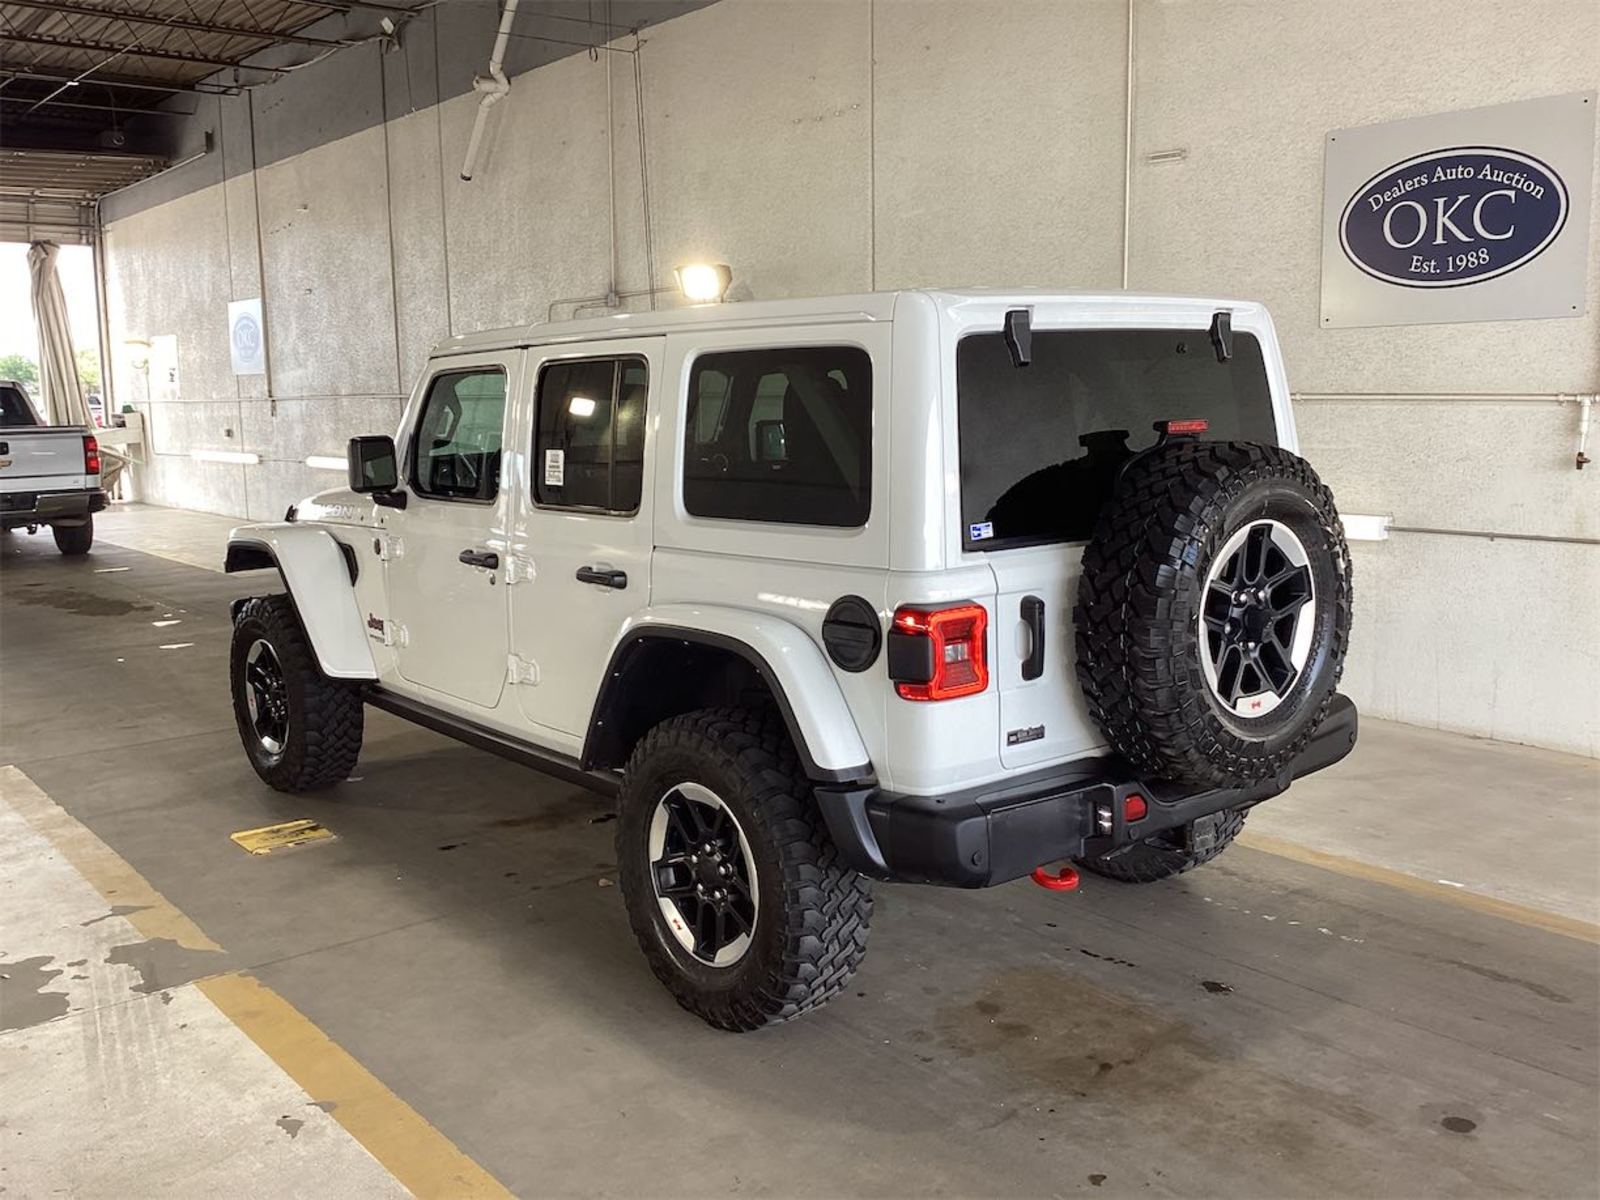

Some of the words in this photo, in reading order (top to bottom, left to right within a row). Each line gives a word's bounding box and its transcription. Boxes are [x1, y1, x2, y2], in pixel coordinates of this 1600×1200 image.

[1368, 174, 1428, 212] Dealers
[1432, 166, 1474, 183] Auto
[1477, 164, 1545, 200] Auction
[1383, 189, 1516, 249] OKC
[1409, 256, 1440, 273] Est.
[1447, 248, 1490, 273] 1988
